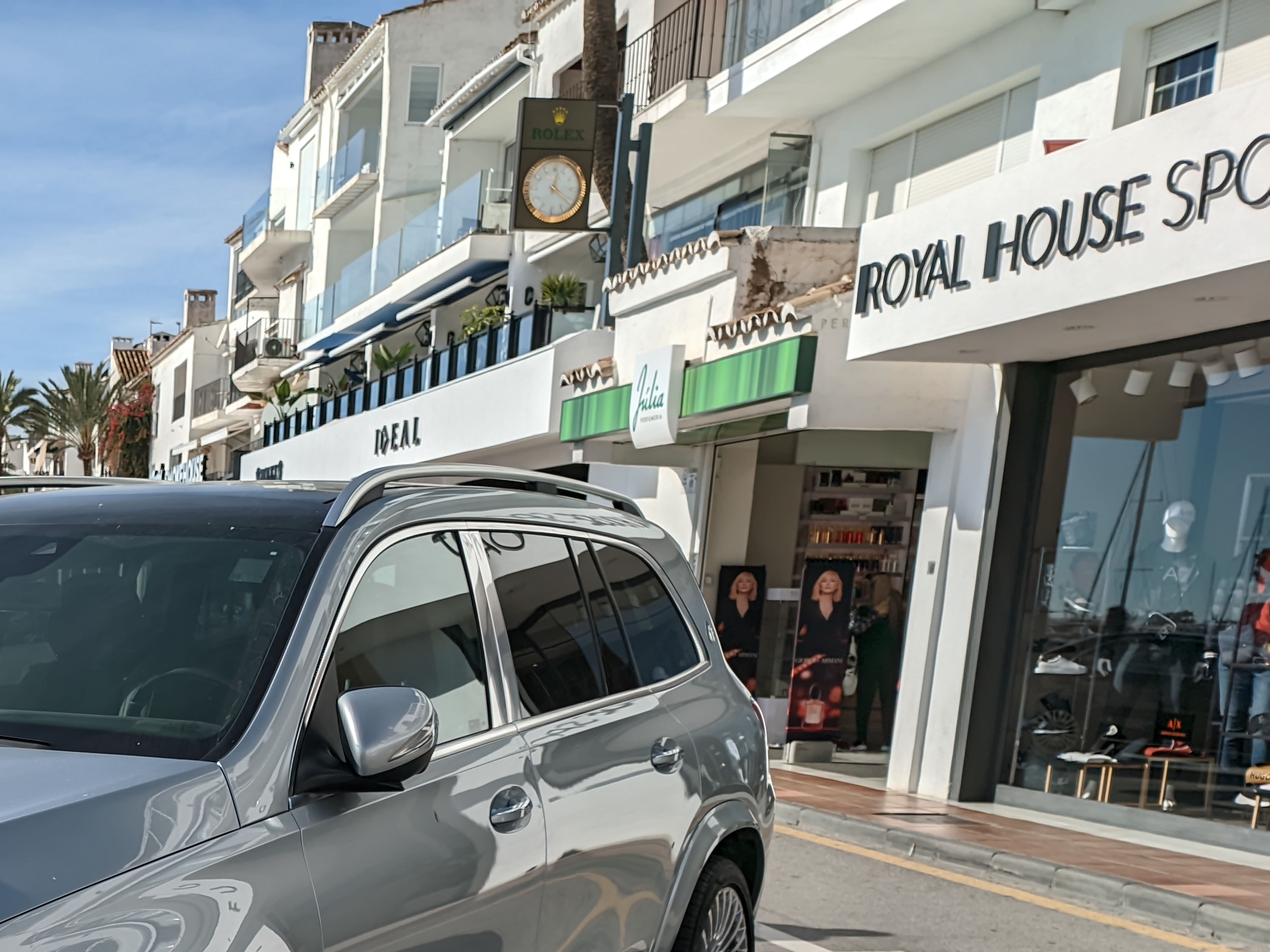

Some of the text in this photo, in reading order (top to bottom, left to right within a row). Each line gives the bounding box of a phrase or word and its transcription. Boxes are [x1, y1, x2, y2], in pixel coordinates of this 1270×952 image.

[532, 127, 585, 141] ROLEX
[854, 234, 970, 315] ROYAL
[982, 173, 1151, 279] HOUSE
[633, 364, 664, 432] Júlia
[373, 416, 422, 458] IDEAL
